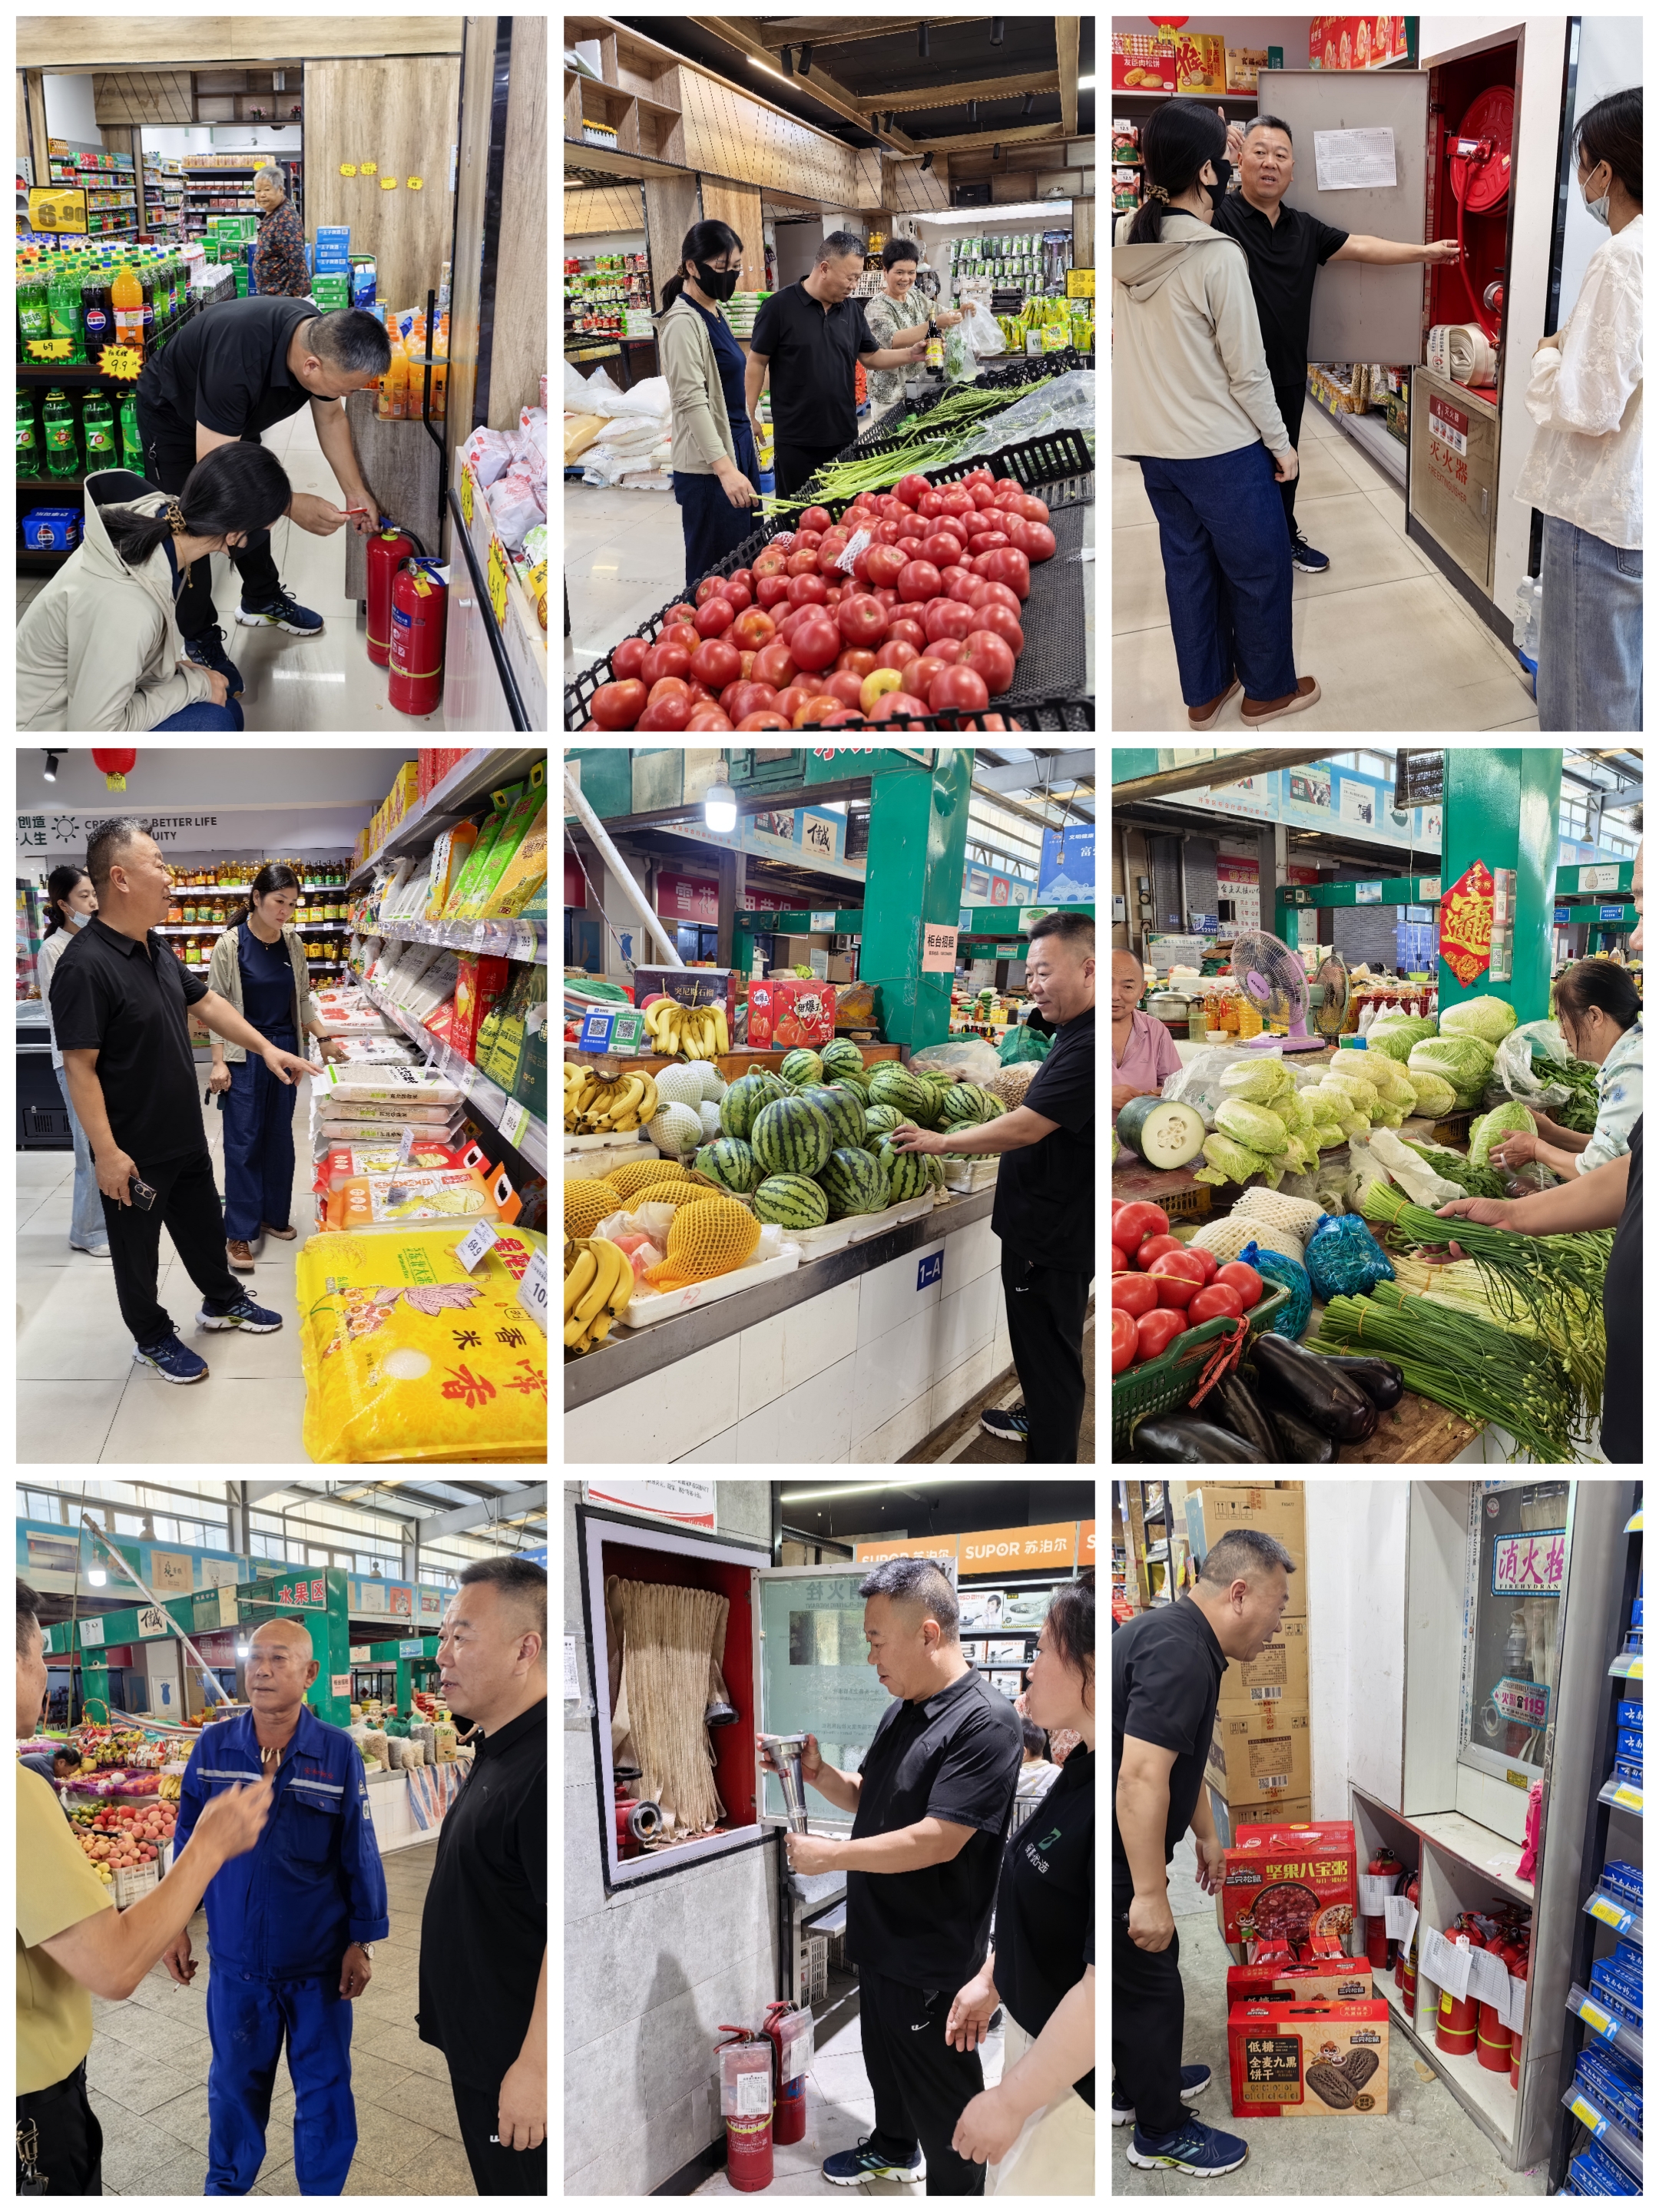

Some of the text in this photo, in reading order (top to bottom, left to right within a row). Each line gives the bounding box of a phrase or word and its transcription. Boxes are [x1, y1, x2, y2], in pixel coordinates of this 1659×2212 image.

[1124, 58, 1161, 68] 友臣肉松饼
[38, 204, 86, 228] 6.90
[111, 359, 128, 372] 9.9
[1444, 406, 1459, 423] 灭火器
[1429, 437, 1468, 485] 灭火器
[1428, 462, 1467, 504] FIRE EXTINGUISHER
[16, 816, 46, 830] 创造
[151, 818, 192, 827] BETTER
[194, 817, 217, 826] LIFE
[16, 832, 48, 846] 人生
[1229, 869, 1259, 883] 讲文明
[675, 882, 715, 915] 雪花
[927, 934, 954, 948] 柜台招租
[674, 986, 714, 998] 突尼斯石榴
[798, 999, 821, 1013] 甜爆王
[467, 1239, 482, 1257] 69.9
[920, 1257, 941, 1283] 1-A
[965, 1541, 1020, 1560] SUPOR
[1025, 1538, 1068, 1555] 苏泊尔
[1498, 1536, 1565, 1585] 消火栓
[278, 1579, 324, 1605] 水果区
[199, 1636, 231, 1661] 雪花
[1502, 1691, 1545, 1717] 火警 119
[1266, 1860, 1348, 1881] 坚果八宝粥
[1226, 1874, 1263, 1884] 三只松鼠
[1339, 1986, 1365, 1995] 三只松鼠
[1247, 2041, 1274, 2054] 低糖
[1249, 2056, 1297, 2069] 全麦九黑
[1250, 2068, 1274, 2081] 饼干
